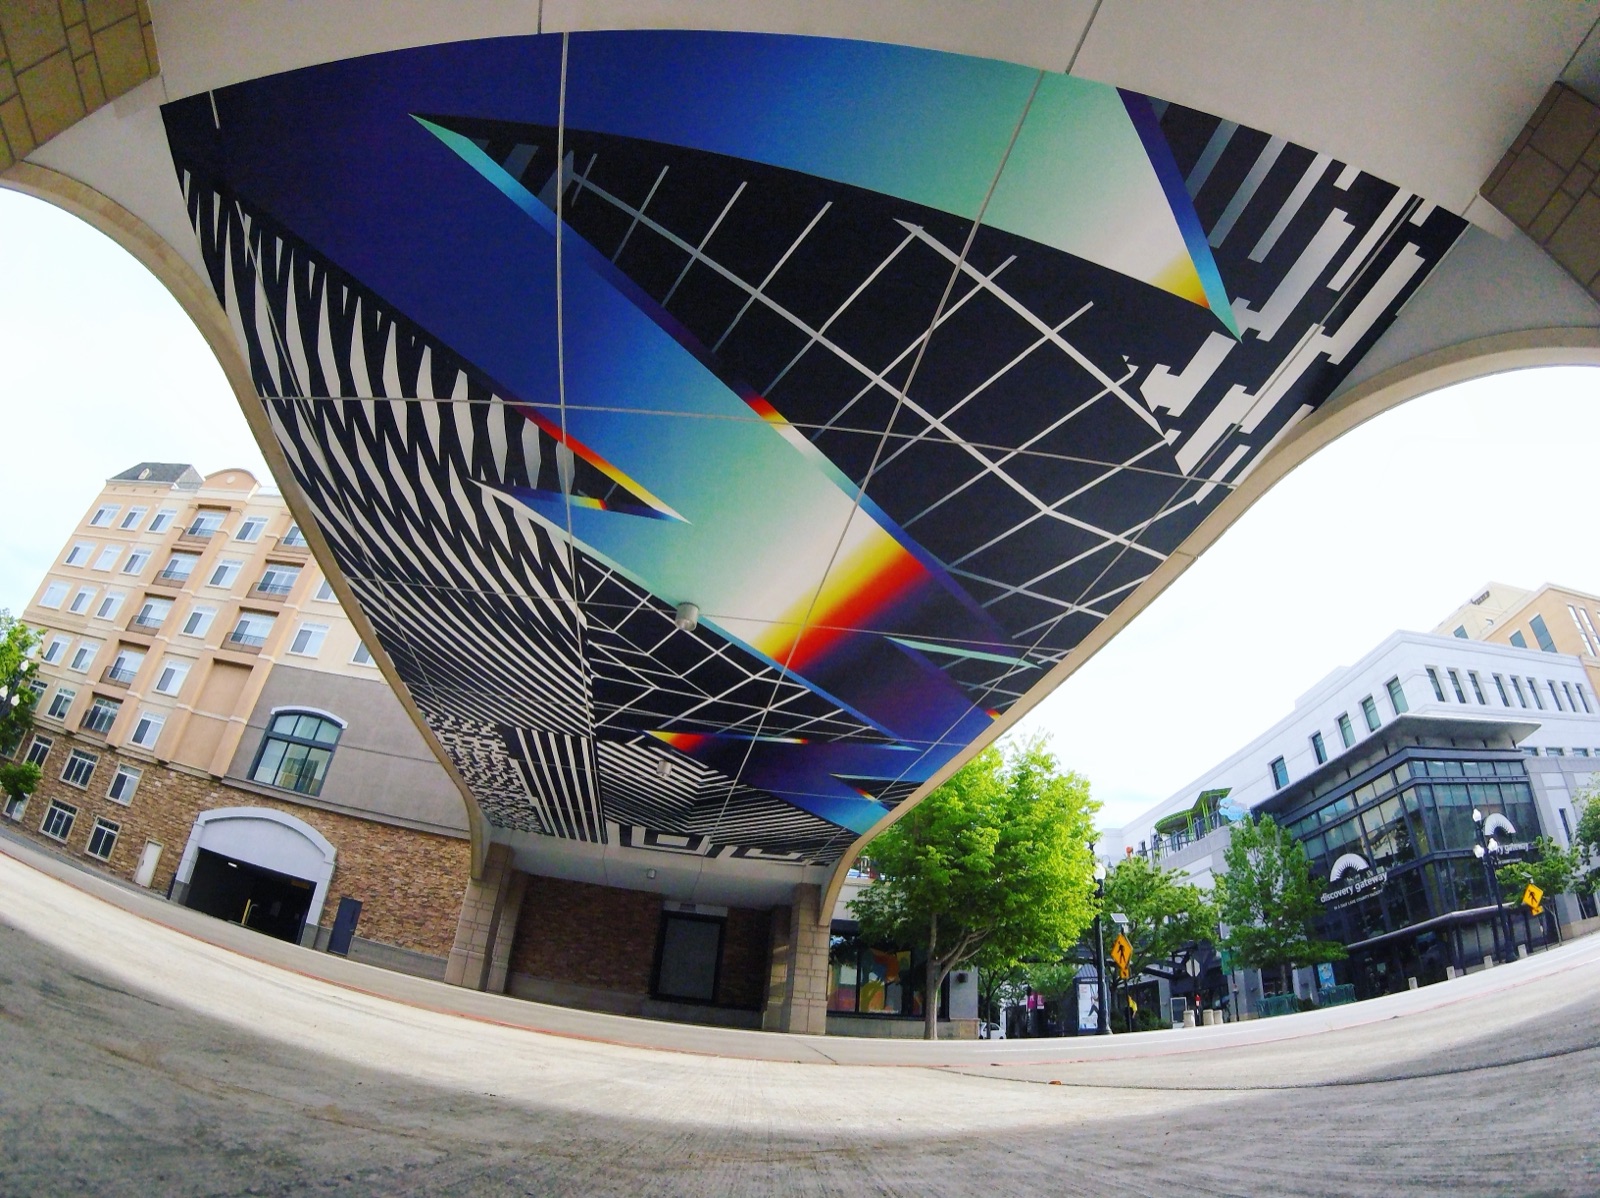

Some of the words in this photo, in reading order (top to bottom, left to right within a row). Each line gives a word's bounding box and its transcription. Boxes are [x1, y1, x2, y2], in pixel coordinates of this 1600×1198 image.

[1505, 842, 1529, 854] gateway
[1320, 885, 1353, 903] discovery
[1354, 872, 1387, 892] gateway
